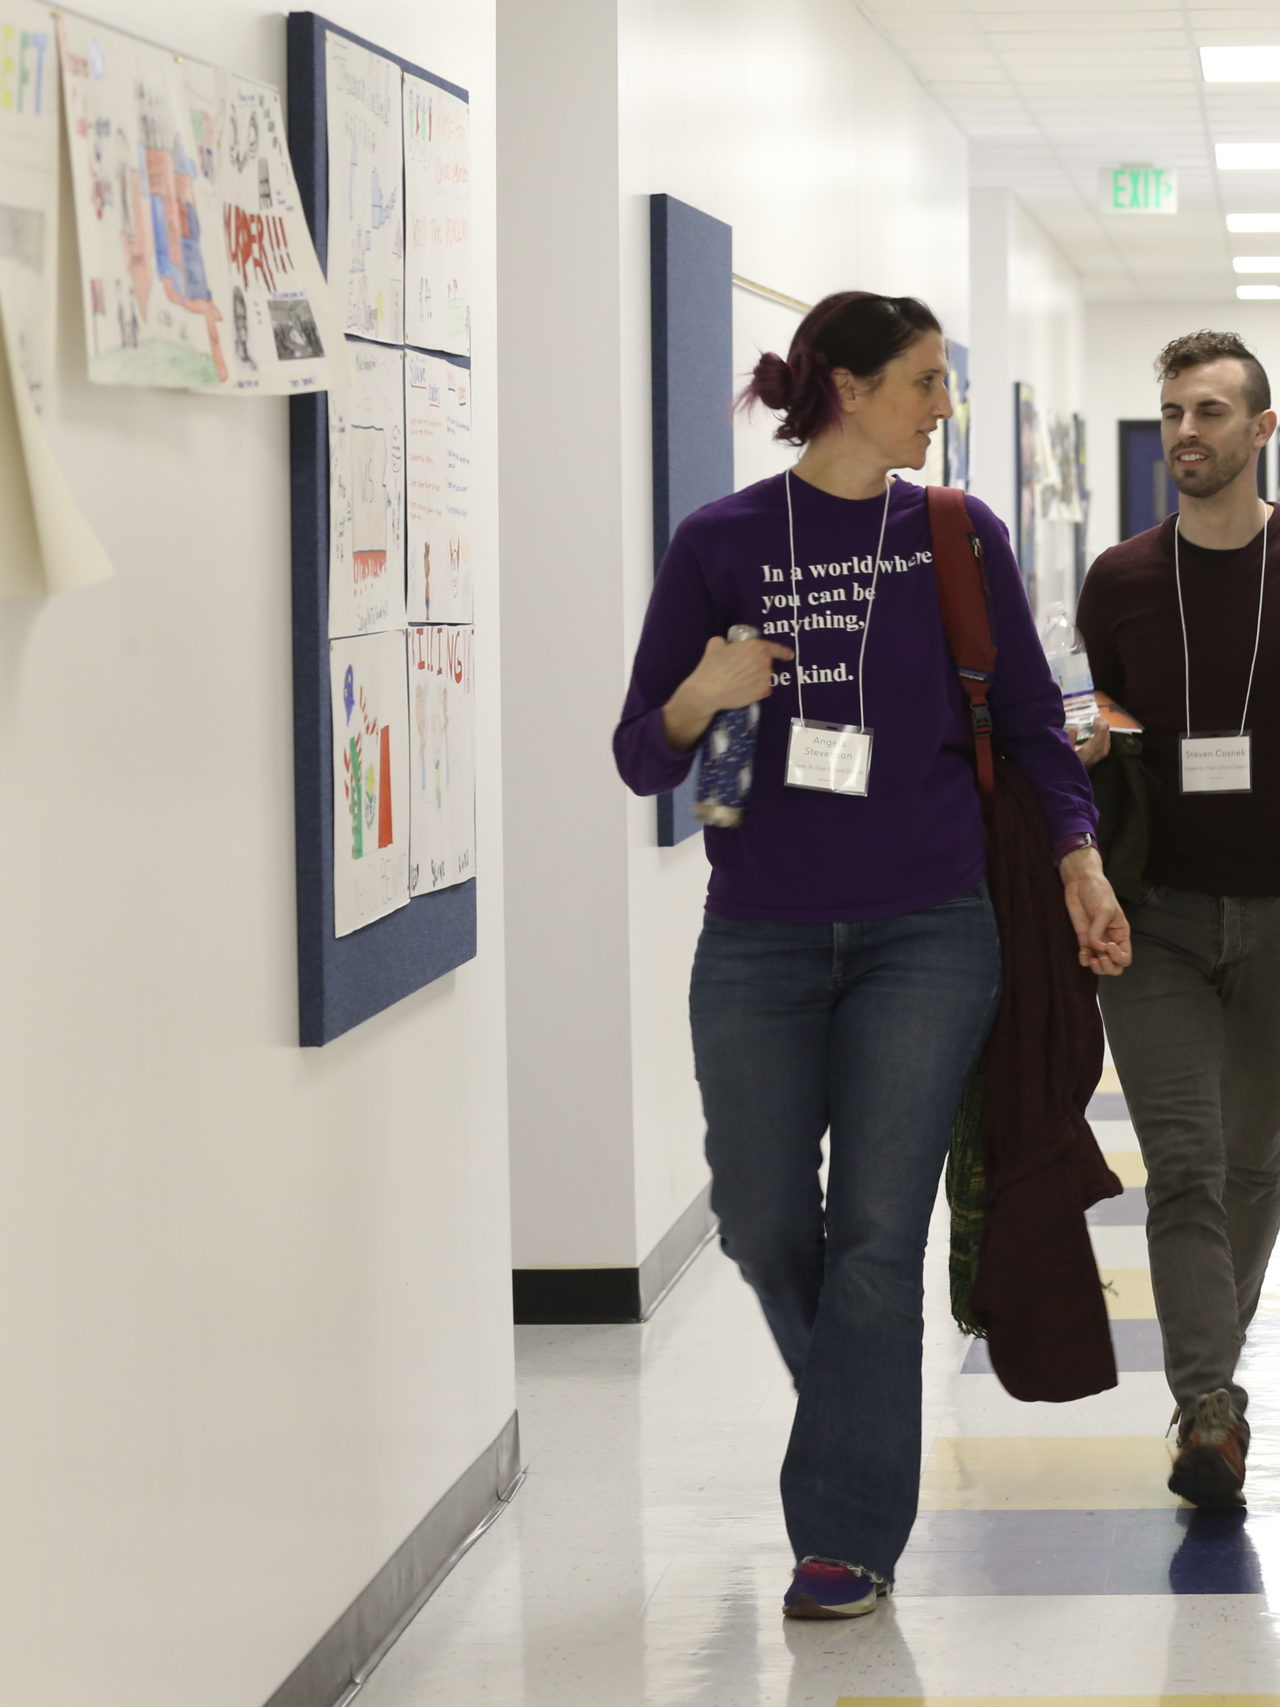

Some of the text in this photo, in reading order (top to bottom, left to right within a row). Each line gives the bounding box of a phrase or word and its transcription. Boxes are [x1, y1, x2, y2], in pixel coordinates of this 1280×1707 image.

[1112, 169, 1165, 208] EXIT
[761, 550, 933, 583] In a world where
[761, 582, 876, 614] you can be
[762, 610, 865, 637] anything,
[798, 663, 854, 685] kind.
[804, 746, 853, 760] Steveon
